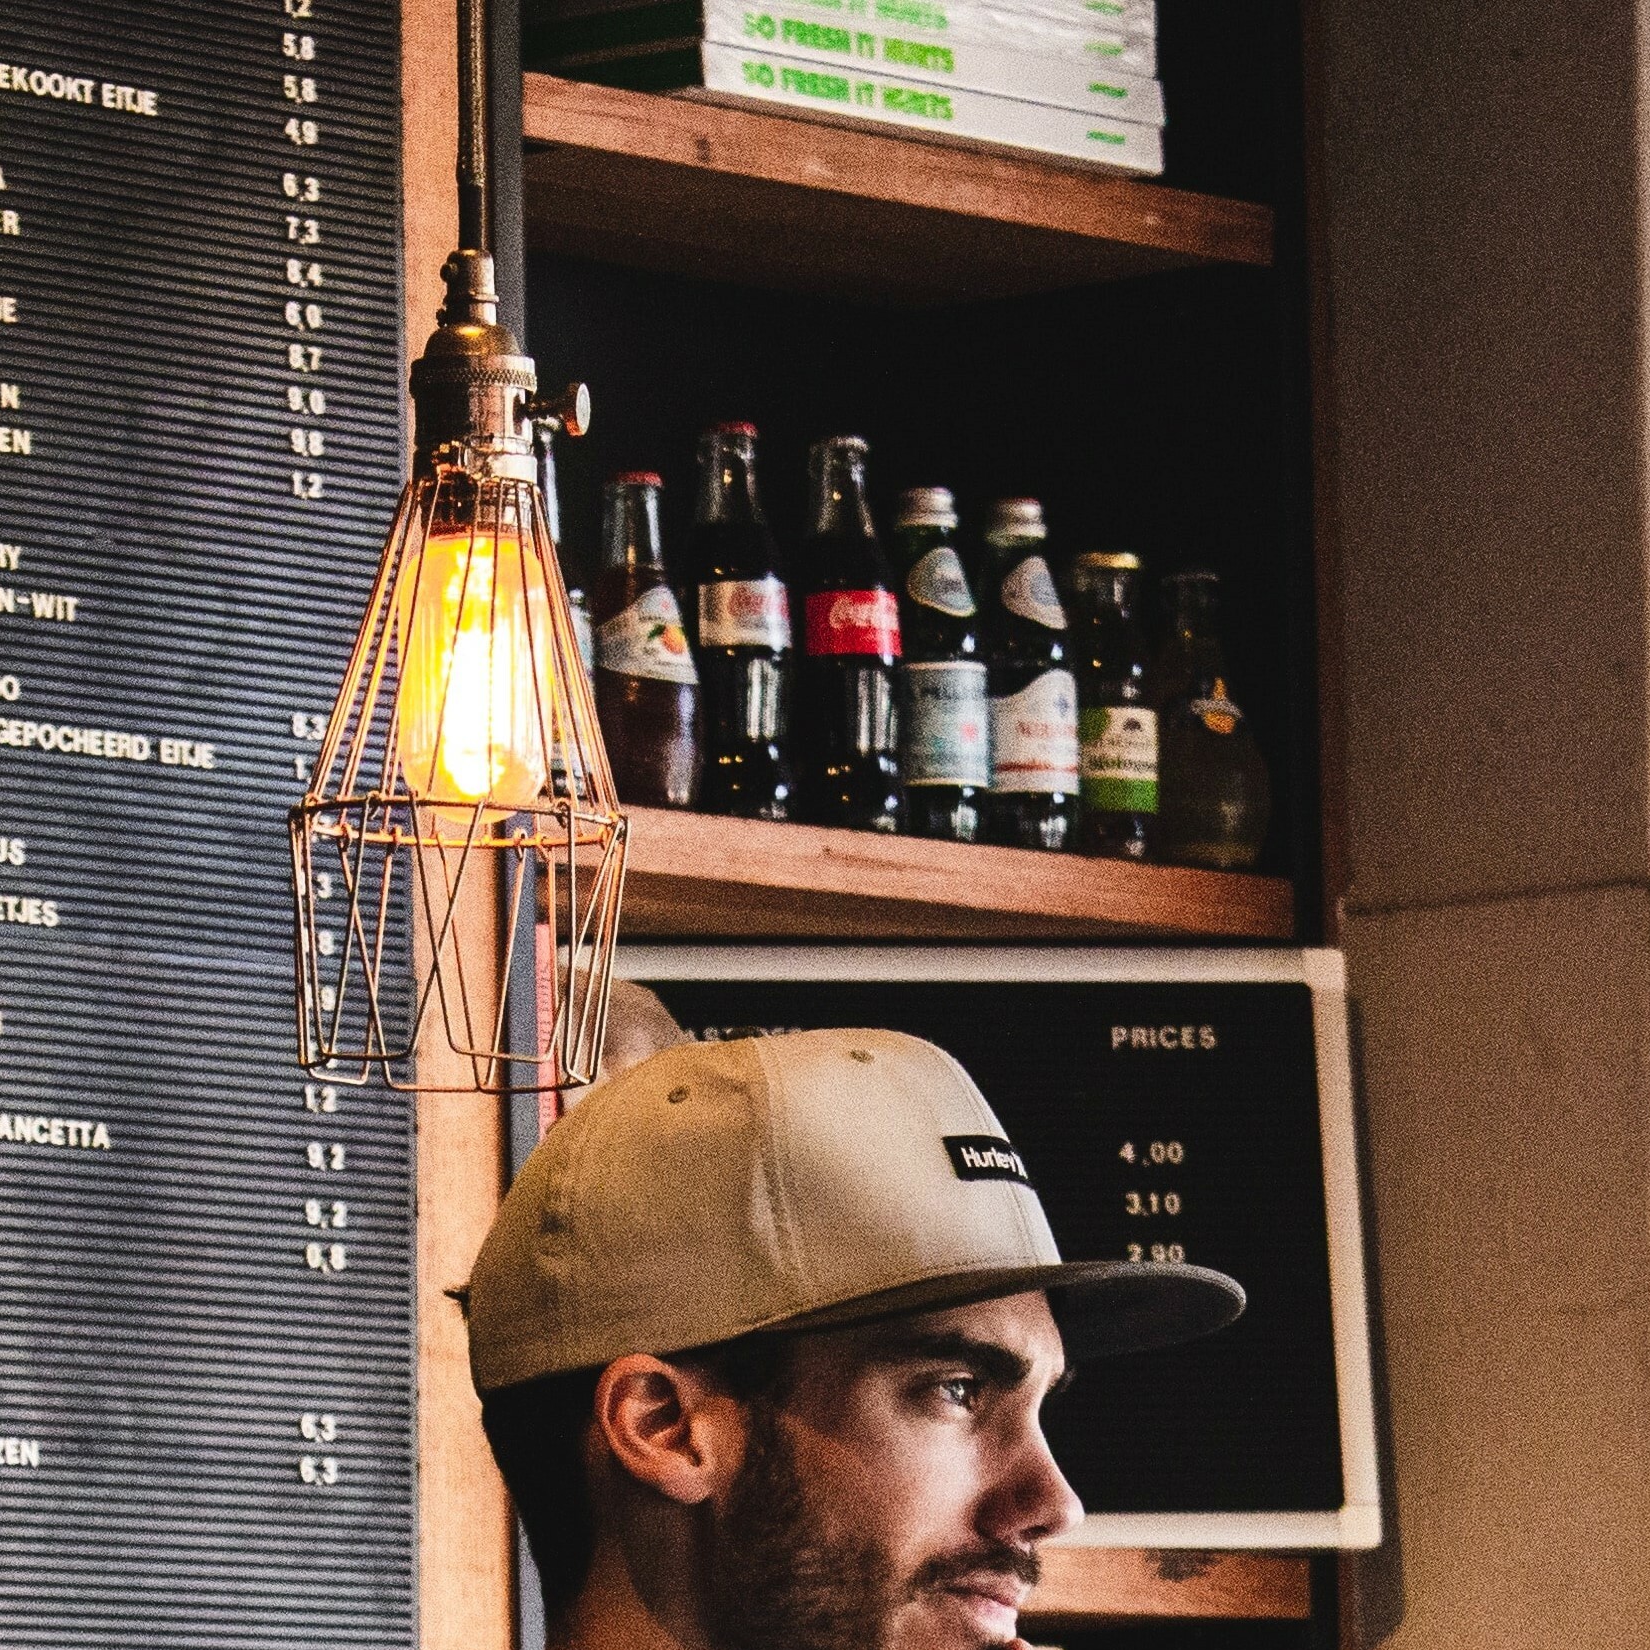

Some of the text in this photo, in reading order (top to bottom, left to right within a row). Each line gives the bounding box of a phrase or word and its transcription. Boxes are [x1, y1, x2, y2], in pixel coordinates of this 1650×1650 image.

[102, 83, 158, 116] EITJE
[159, 739, 215, 770] EITJE
[1111, 1024, 1218, 1050] PRICES
[961, 1146, 1016, 1172] Hurley
